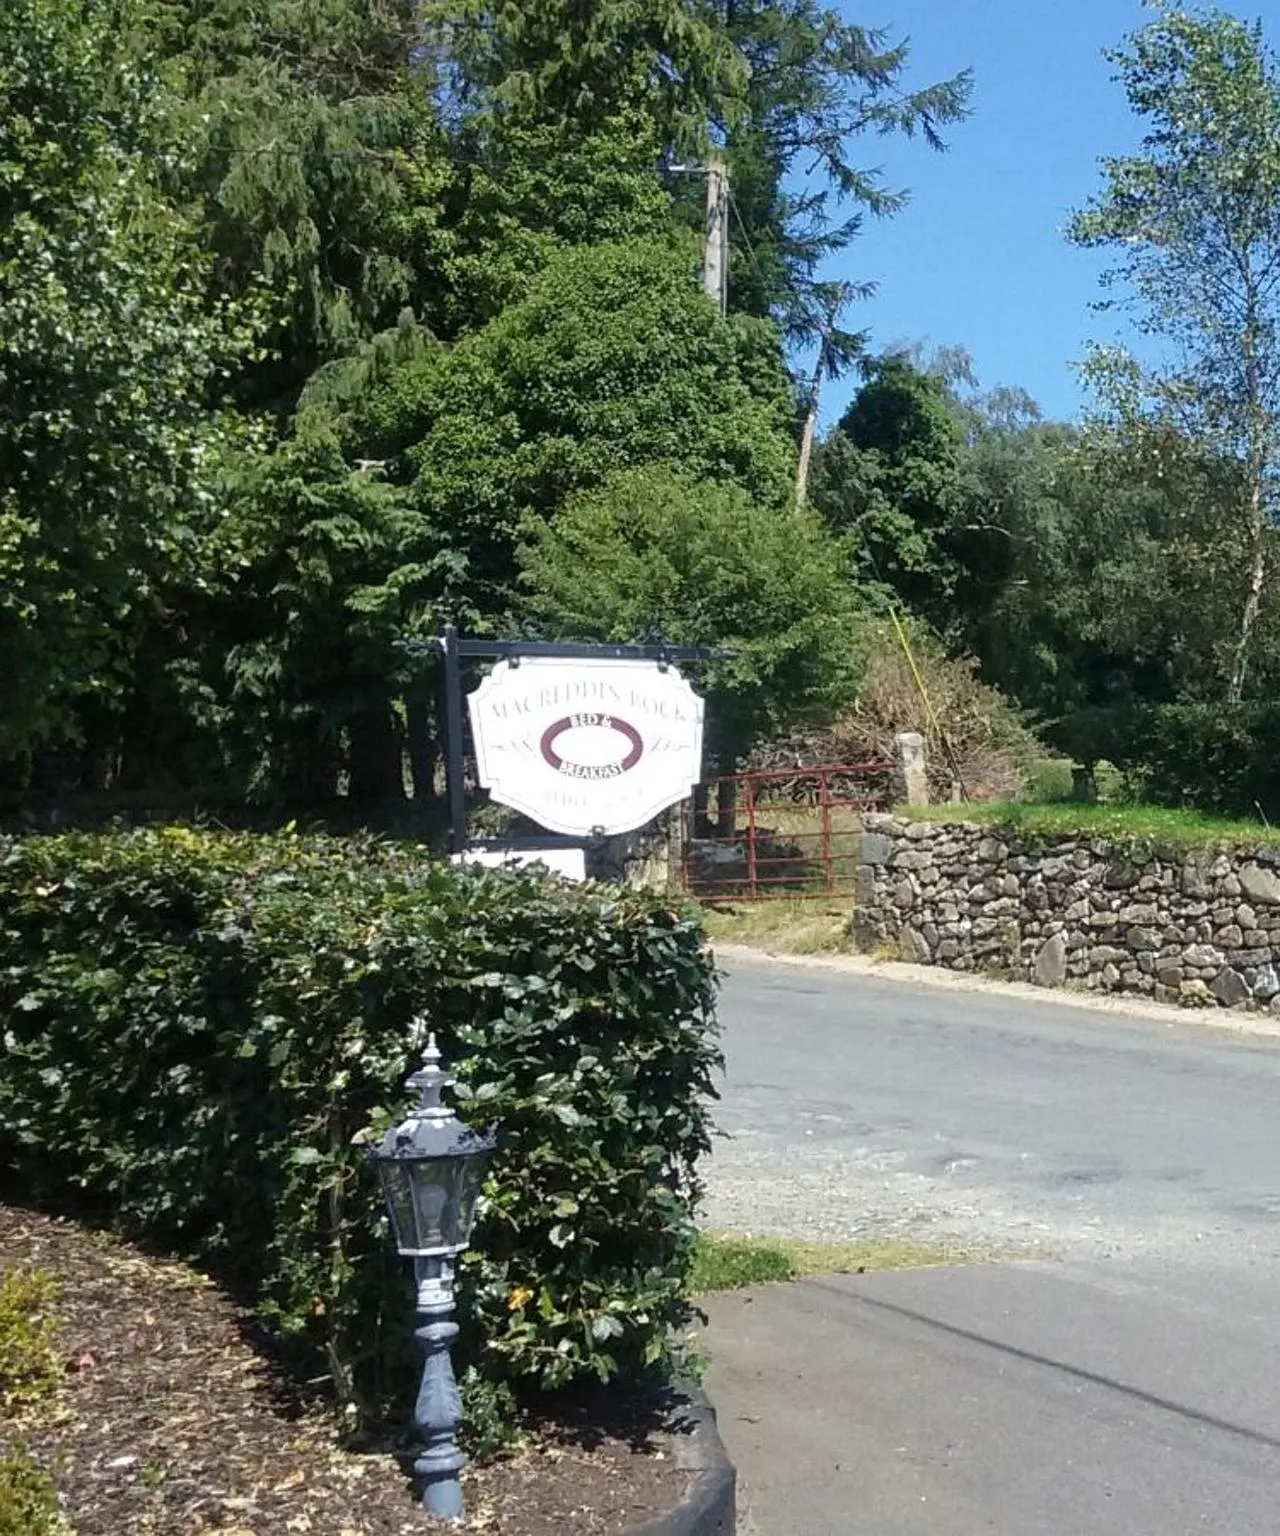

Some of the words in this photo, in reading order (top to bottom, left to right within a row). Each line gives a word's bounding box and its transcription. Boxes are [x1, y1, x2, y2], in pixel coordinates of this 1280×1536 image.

[570, 713, 598, 728] BED
[601, 714, 613, 728] &
[559, 758, 624, 780] BREAKFAST
